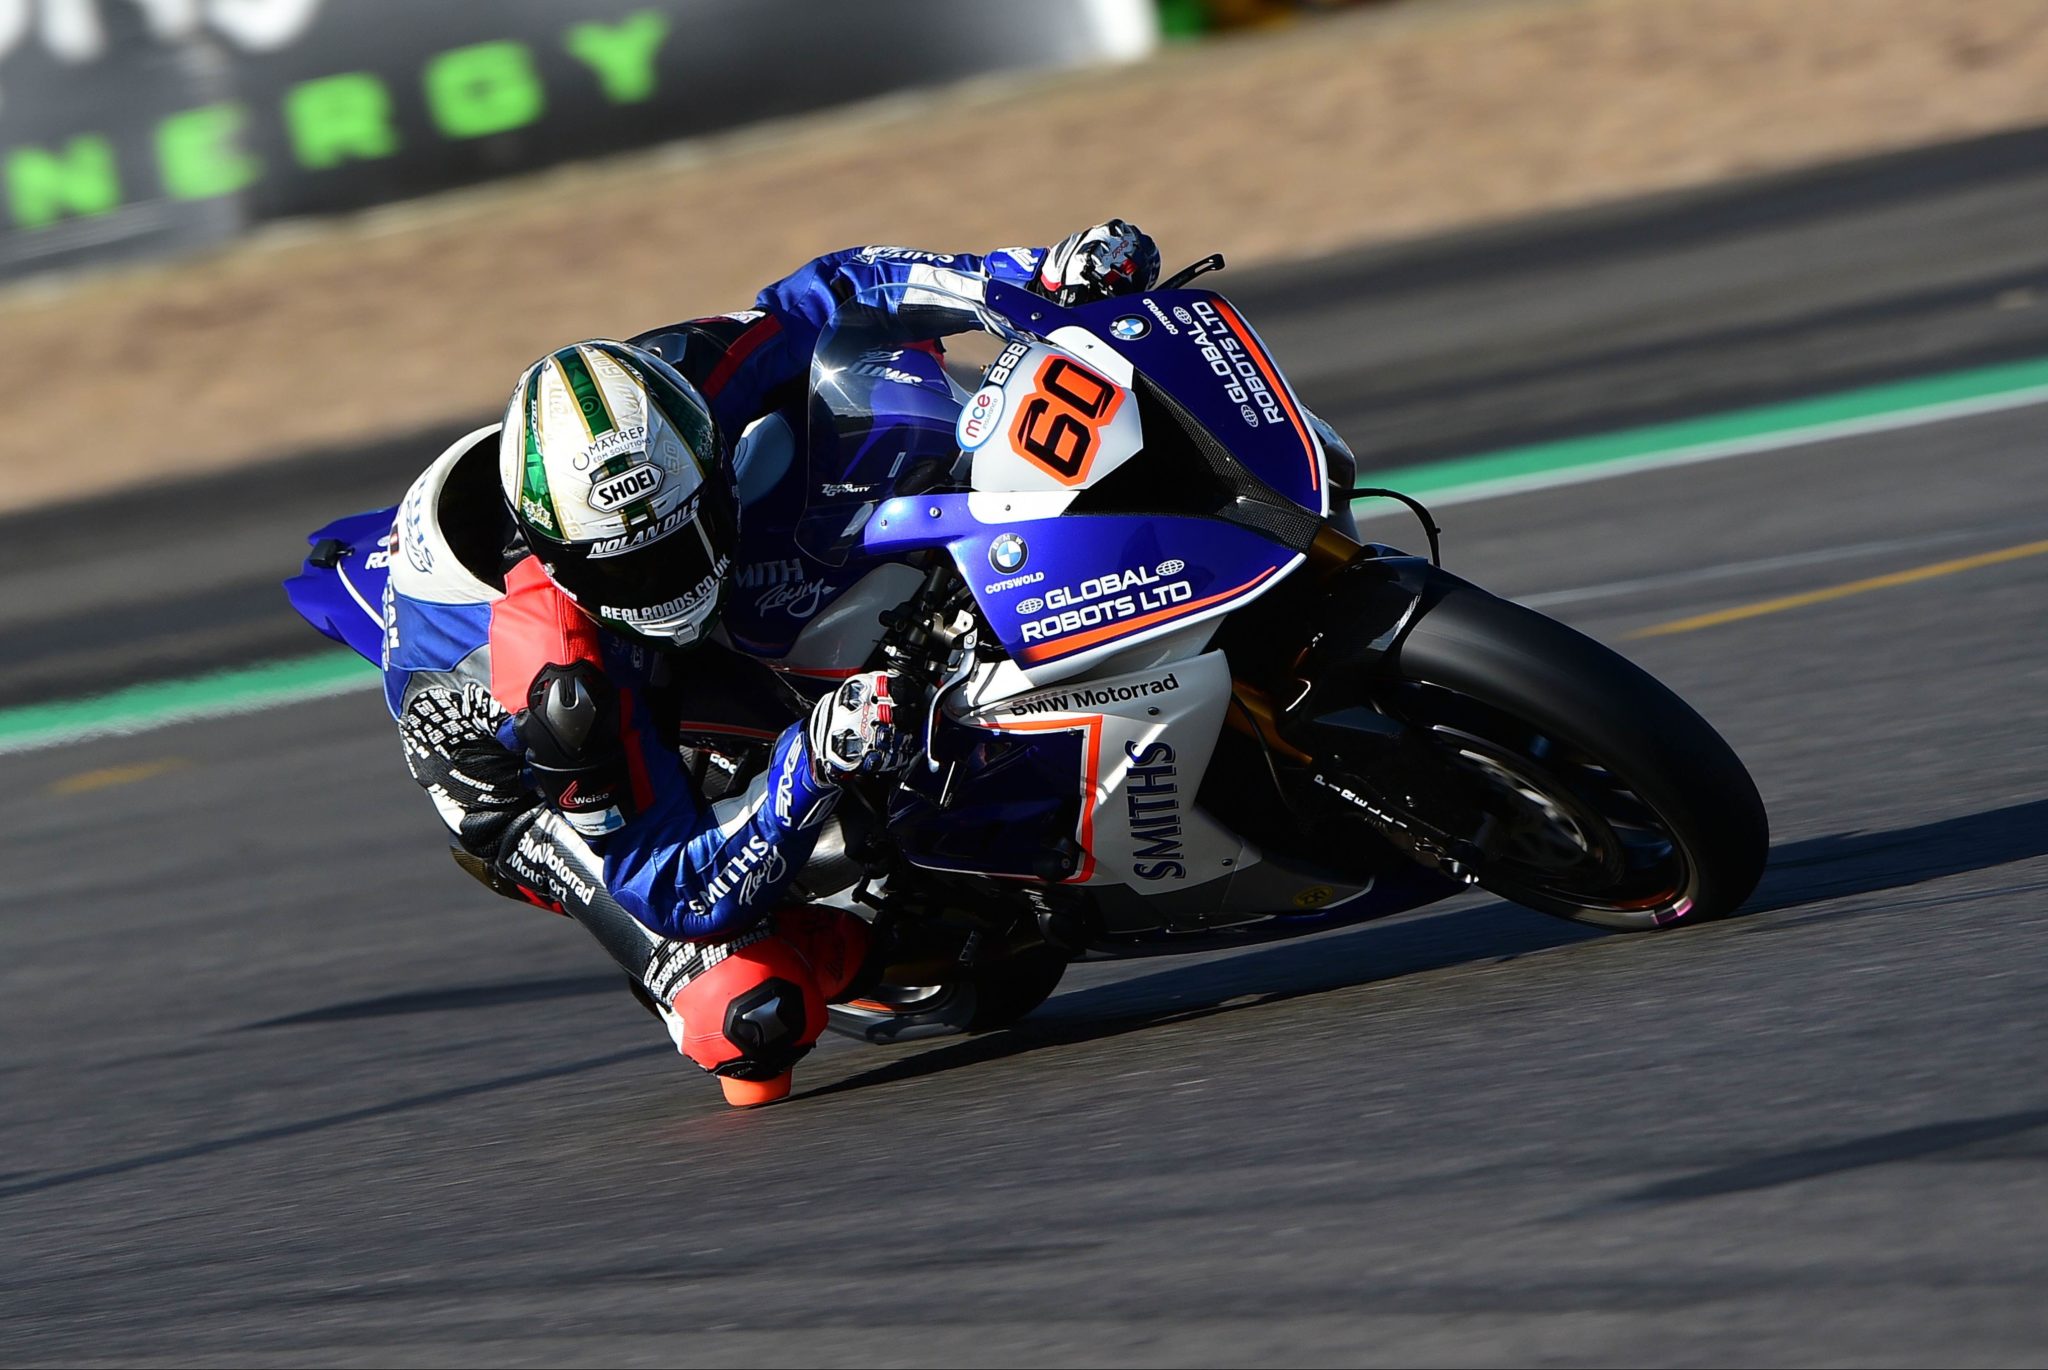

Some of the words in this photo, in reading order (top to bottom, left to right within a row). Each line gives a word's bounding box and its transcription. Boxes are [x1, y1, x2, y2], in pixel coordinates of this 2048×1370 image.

[1142, 298, 1179, 335] COTSWOLD
[1193, 301, 1229, 336] LTD
[988, 342, 1028, 386] BSB
[1188, 321, 1249, 404] GLOBAL
[1220, 336, 1285, 424] ROBOTS
[588, 426, 645, 455] MAKREP
[965, 394, 991, 439] mce
[1013, 356, 1121, 483] 60
[598, 468, 656, 506] SHOEI
[589, 522, 660, 555] NOLAN
[662, 498, 701, 529] OILS
[600, 553, 731, 622] REALROADS.CO.UK
[754, 578, 826, 618] Racing
[984, 571, 1045, 595] COTSWOLD
[1045, 566, 1160, 610] GLOBAL
[1020, 595, 1136, 643] ROBOTS
[1138, 580, 1192, 610] LTD
[1009, 692, 1069, 717] BMW
[1069, 673, 1179, 710] Motorrad
[1124, 739, 1186, 881] SMITHS
[1313, 773, 1408, 829] PIRELLI
[688, 833, 770, 917] SMITHS
[738, 845, 787, 906] Racing
